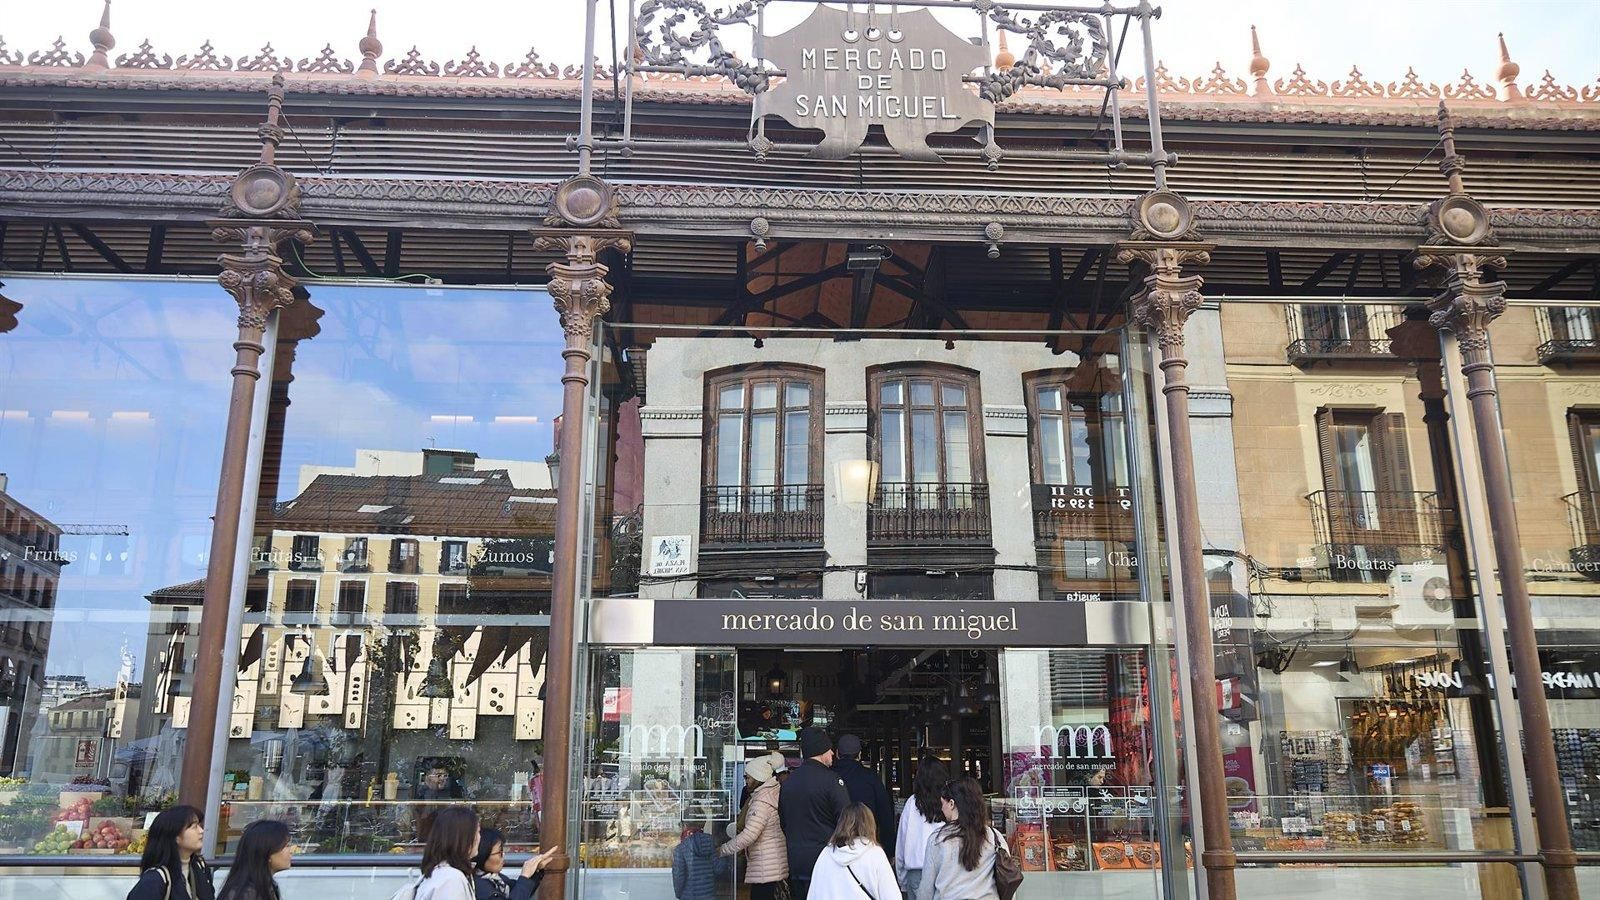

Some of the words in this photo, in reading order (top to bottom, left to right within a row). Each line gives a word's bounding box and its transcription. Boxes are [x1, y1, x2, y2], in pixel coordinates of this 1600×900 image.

[802, 48, 947, 71] MERCADO
[858, 74, 892, 90] DE
[796, 94, 848, 117] SAN
[858, 92, 961, 120] MIGUEL
[23, 545, 78, 561] Frutas
[251, 546, 302, 562] Frutas
[478, 547, 534, 563] Zumos
[1335, 554, 1397, 571] Bocatas
[721, 606, 834, 631] mercado
[842, 606, 873, 631] de
[880, 613, 925, 631] san
[932, 608, 1019, 640] miguel
[1032, 762, 1064, 770] mercado
[1065, 762, 1075, 770] de
[1091, 762, 1117, 772] miguel
